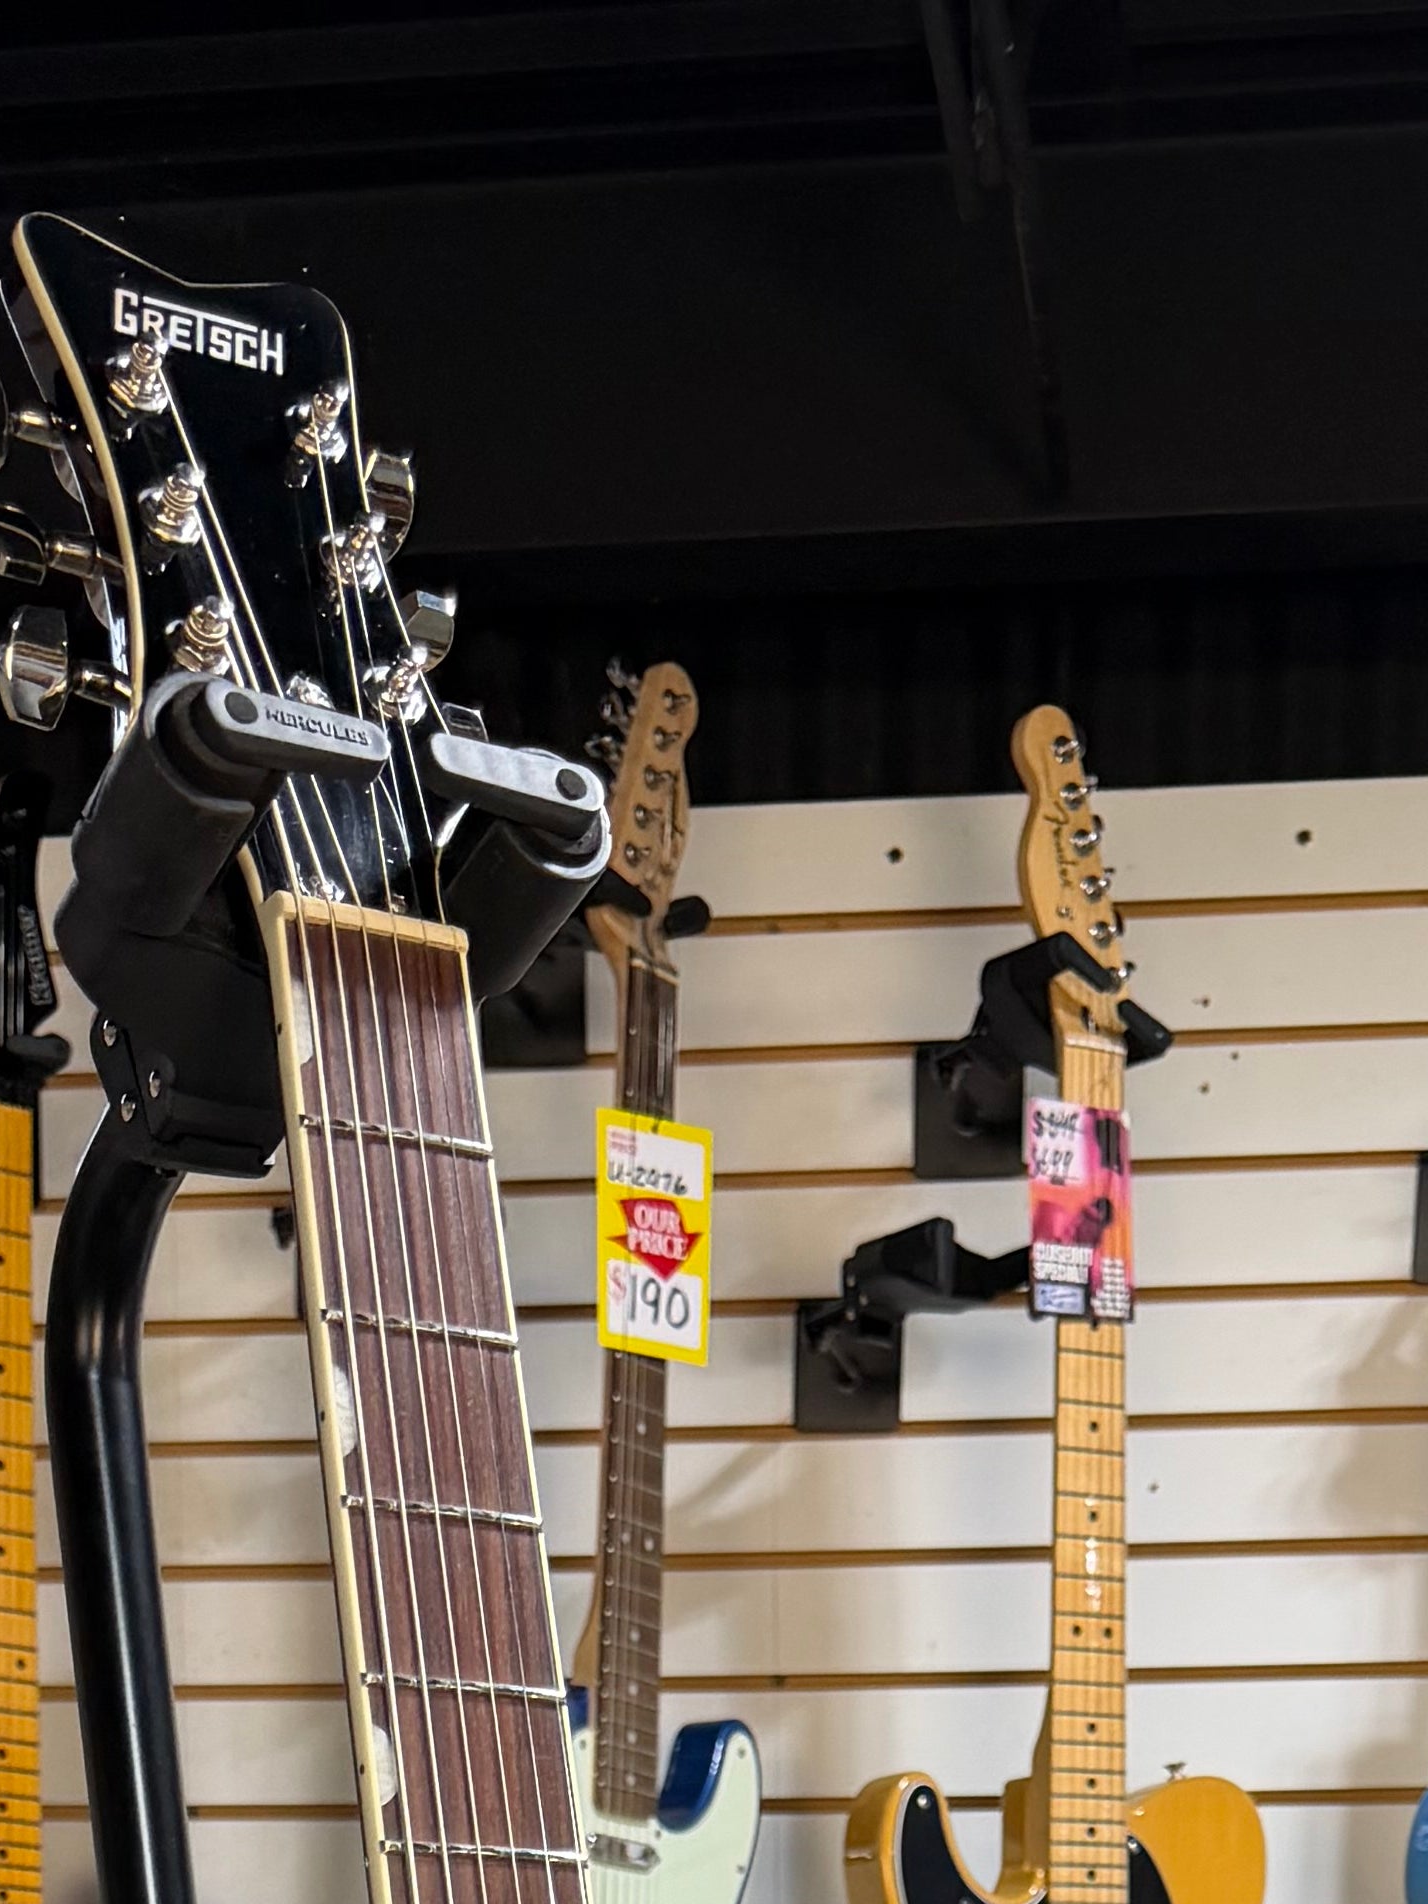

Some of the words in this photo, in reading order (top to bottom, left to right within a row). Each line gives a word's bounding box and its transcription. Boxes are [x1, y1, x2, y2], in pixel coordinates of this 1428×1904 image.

[265, 705, 369, 746] HERCULES
[633, 1200, 681, 1235] OUR
[627, 1227, 689, 1260] PRICE
[609, 1266, 690, 1329] $190
